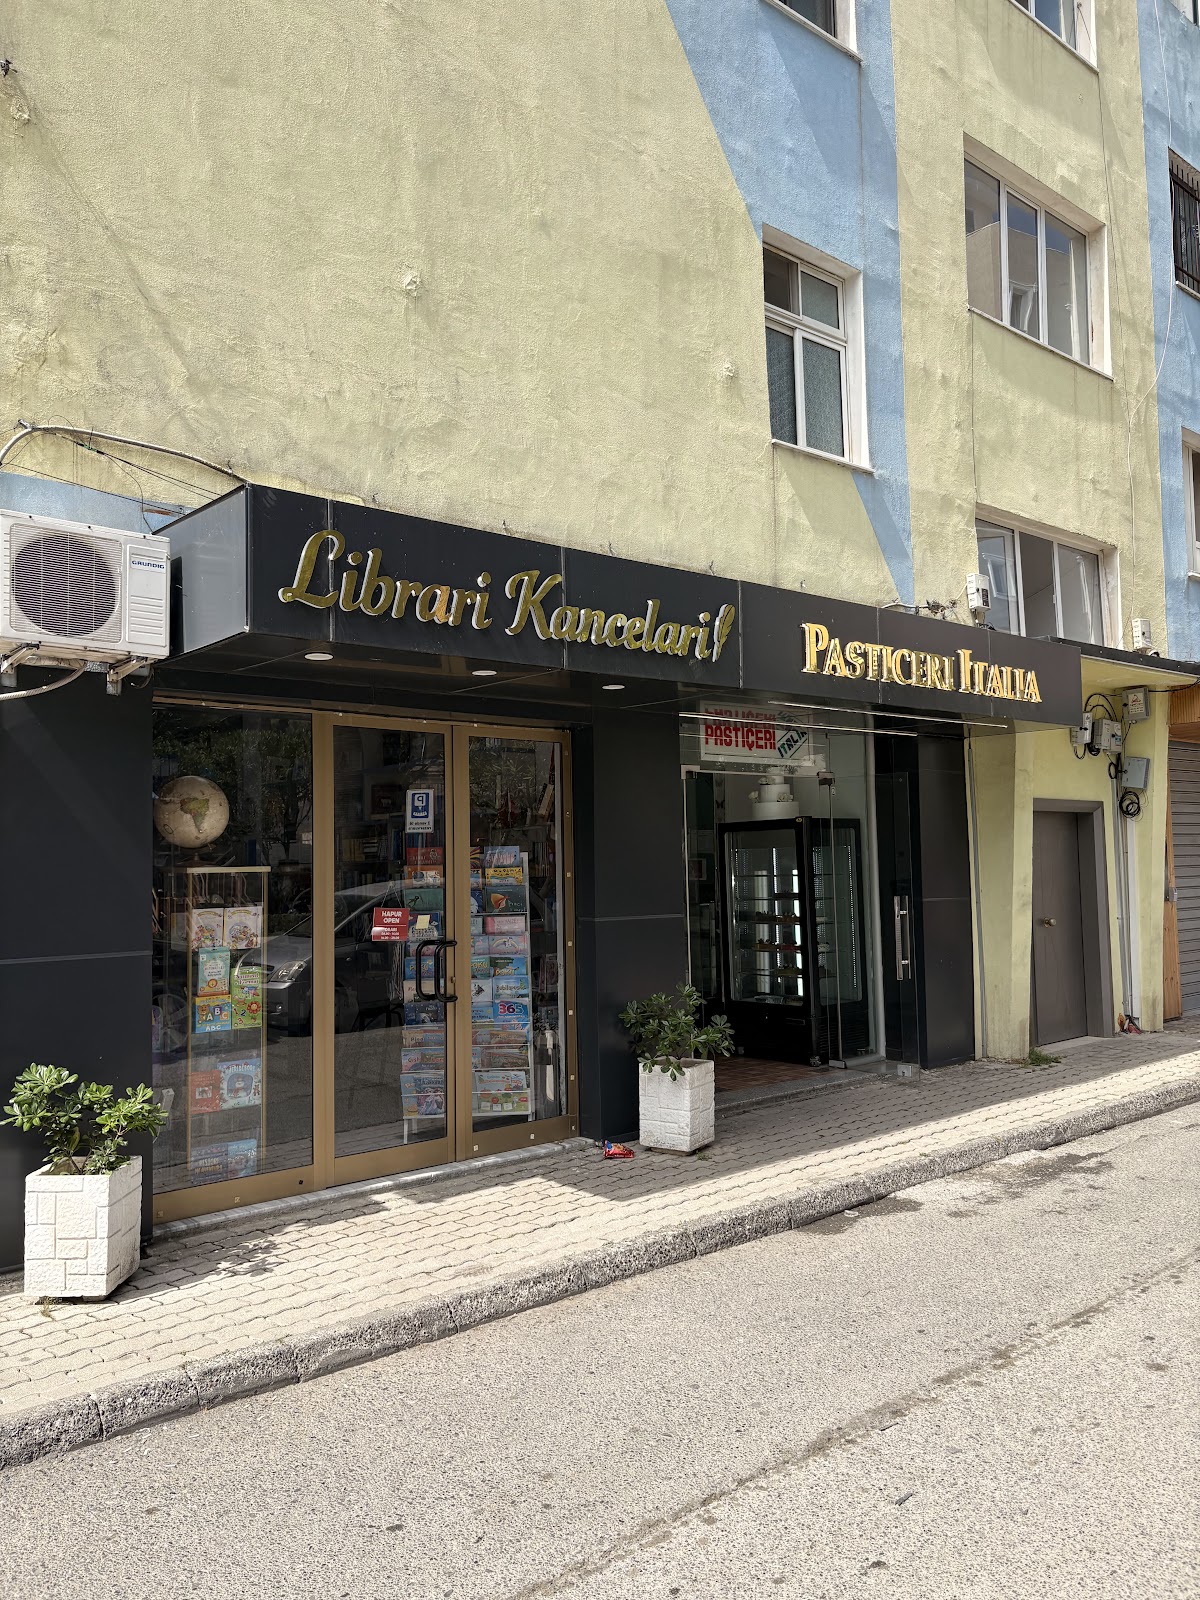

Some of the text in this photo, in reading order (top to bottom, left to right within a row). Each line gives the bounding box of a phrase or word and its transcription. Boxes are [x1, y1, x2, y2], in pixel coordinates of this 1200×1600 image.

[131, 560, 165, 569] GRUNDIG
[277, 529, 713, 660] Librari Kancelari
[799, 622, 1042, 703] PASTICERI ITALIA
[704, 724, 808, 758] PASTIÇERI ITALIA
[381, 910, 403, 918] HAPUR
[498, 1002, 524, 1014] 365
